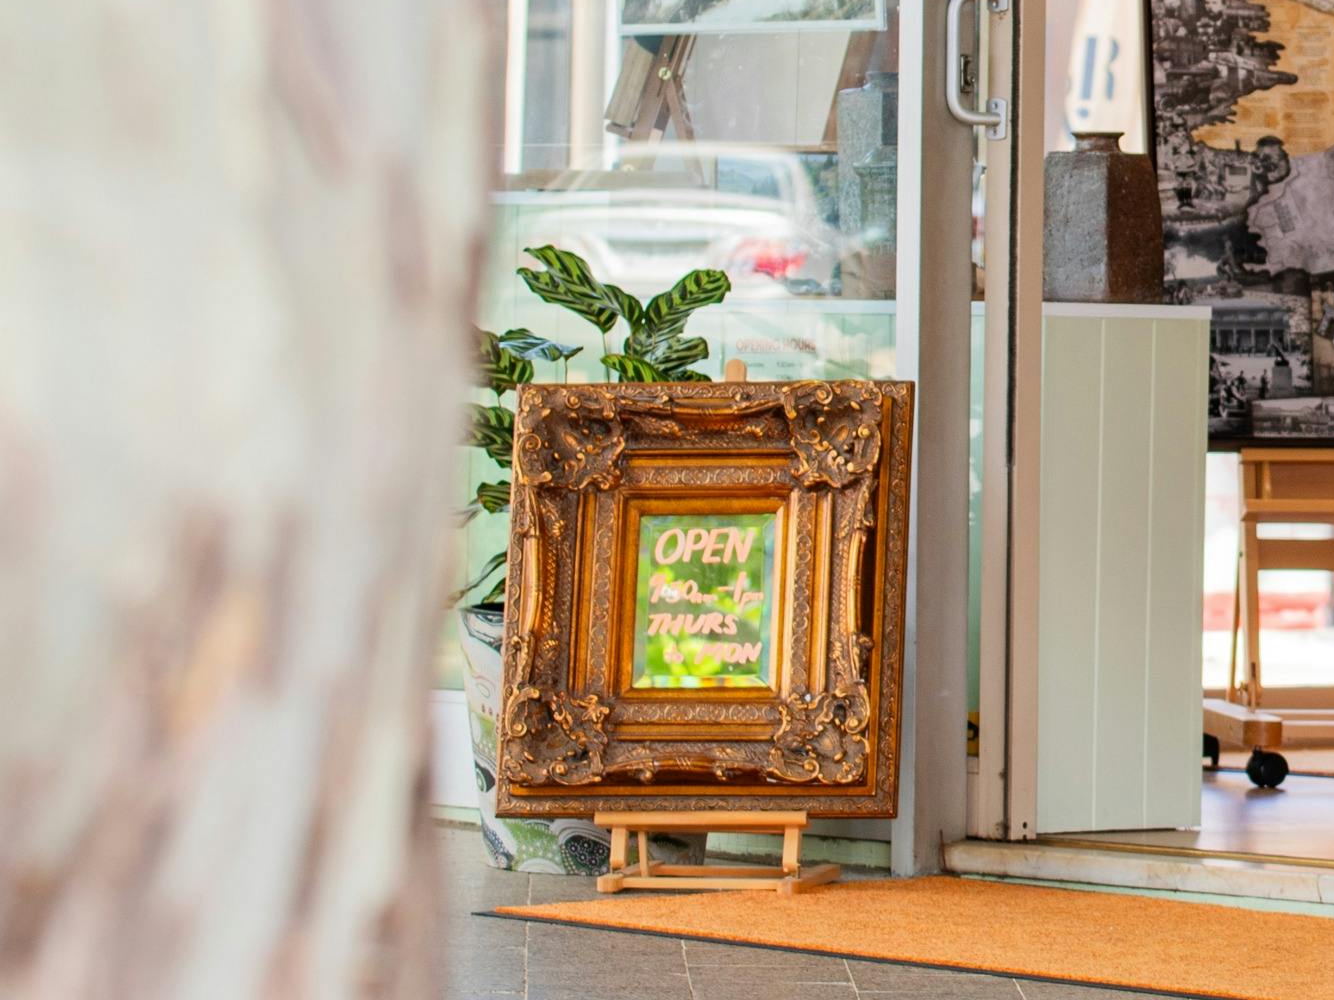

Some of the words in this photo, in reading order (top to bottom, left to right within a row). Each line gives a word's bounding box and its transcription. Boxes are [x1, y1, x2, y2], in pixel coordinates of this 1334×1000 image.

[655, 528, 755, 564] OPEN
[647, 612, 738, 636] THURS
[694, 641, 762, 664] MON
